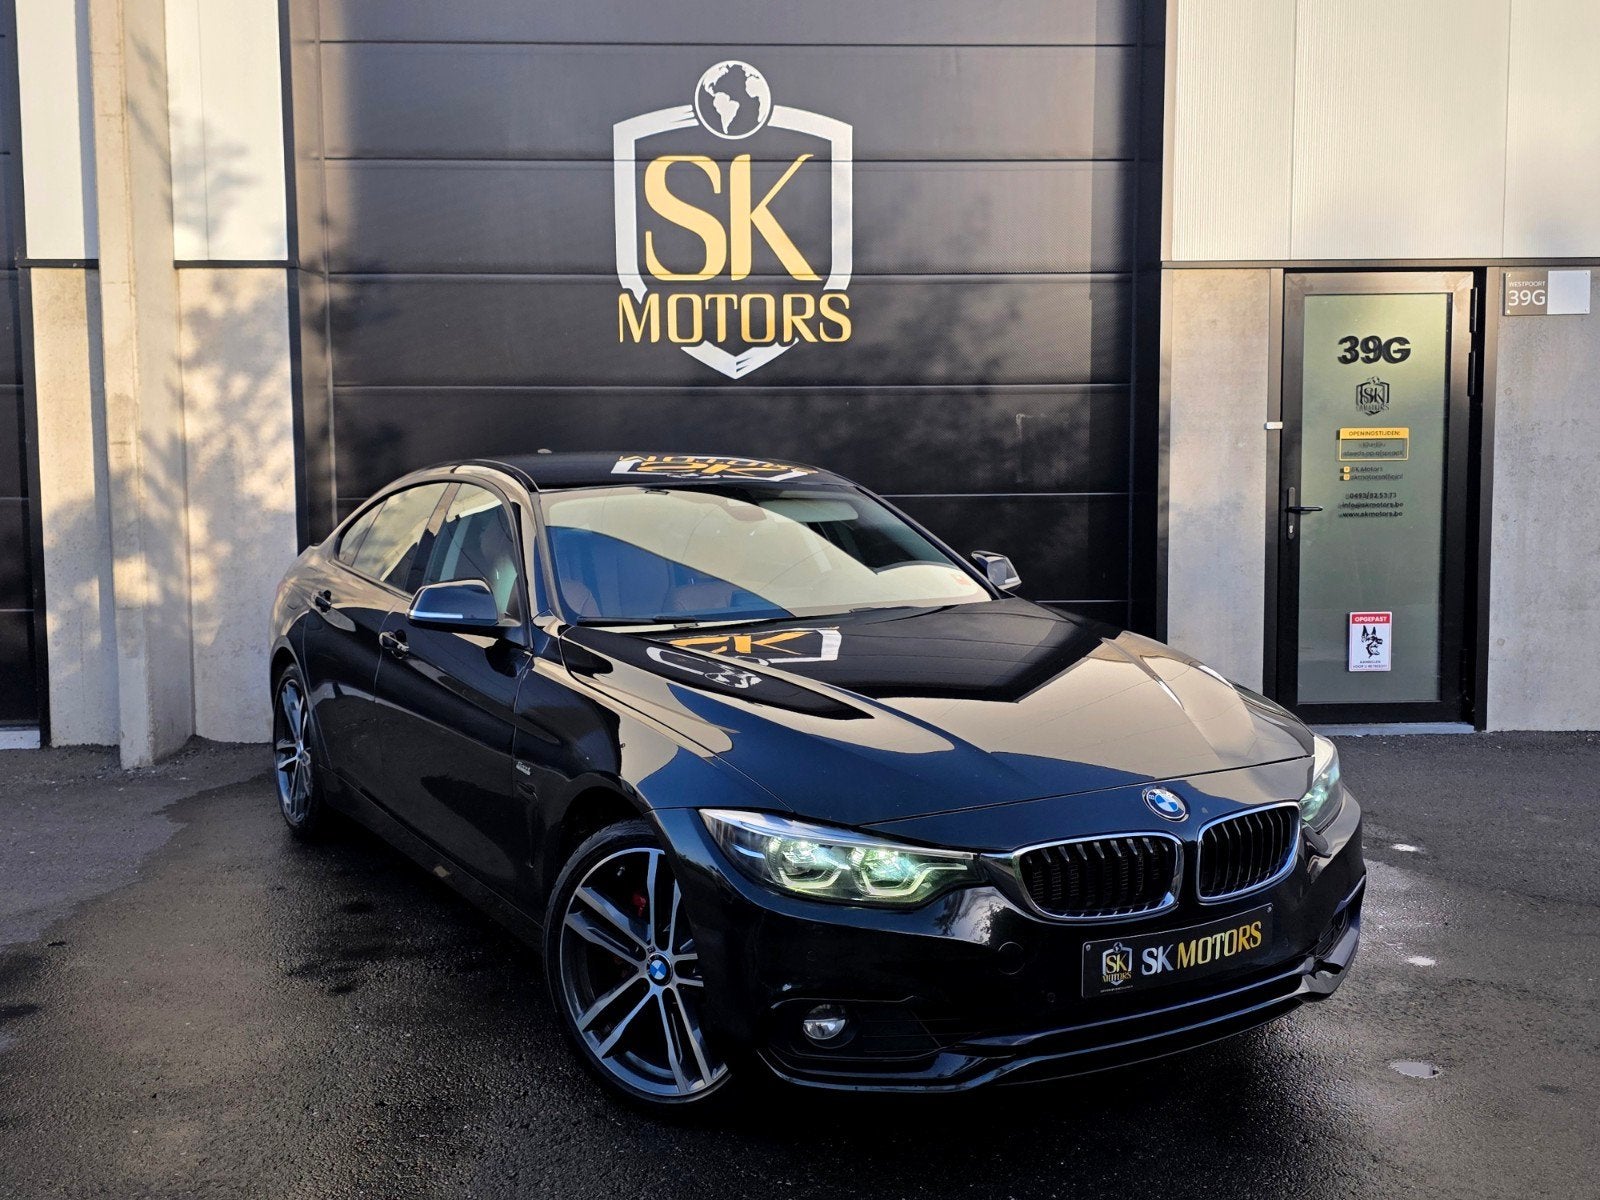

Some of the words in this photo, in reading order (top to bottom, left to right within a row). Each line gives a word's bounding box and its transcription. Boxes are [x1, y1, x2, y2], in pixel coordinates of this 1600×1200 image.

[644, 153, 823, 281] SK
[1508, 280, 1546, 288] WESTPOORT
[1508, 289, 1546, 306] 39G
[618, 293, 852, 343] MOTORS
[1337, 335, 1411, 364] 39G
[1142, 944, 1174, 976] SK
[1177, 920, 1262, 970] MOTORS
[1106, 952, 1128, 974] SK
